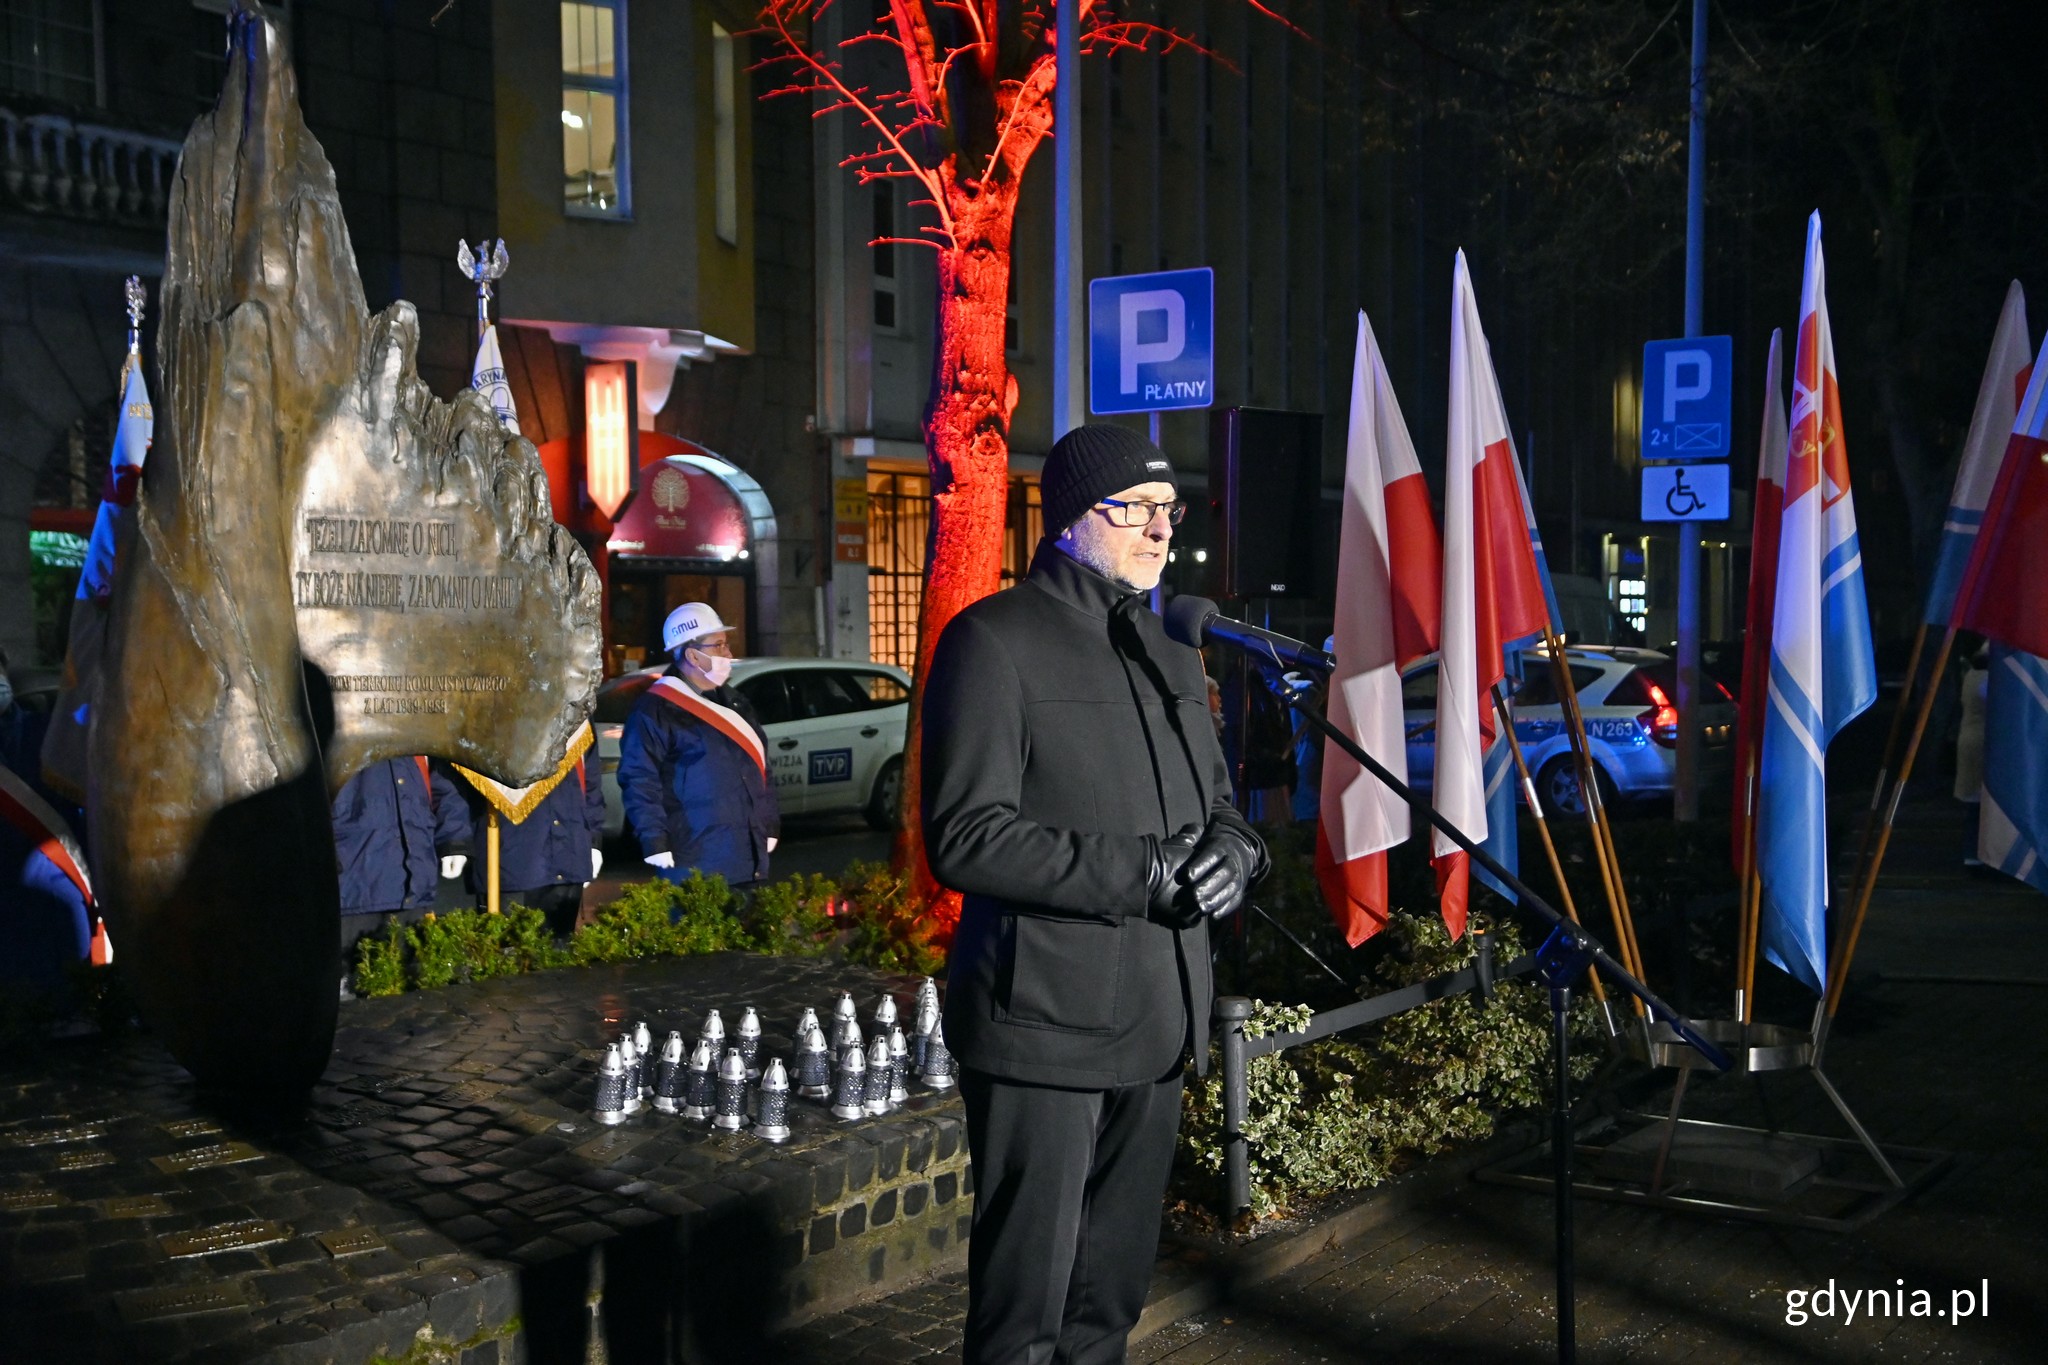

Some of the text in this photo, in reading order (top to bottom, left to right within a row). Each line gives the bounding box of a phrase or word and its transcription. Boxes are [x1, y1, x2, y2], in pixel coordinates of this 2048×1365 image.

[1120, 288, 1185, 395] P
[1145, 380, 1206, 401] PŁATNY
[1663, 349, 1712, 423] P
[348, 519, 410, 558] ZAPOMNĘ
[413, 521, 424, 556] O
[408, 574, 470, 612] ZAPOMNIJ
[472, 576, 481, 609] O
[364, 698, 372, 714] Z
[373, 698, 394, 714] LAT
[1592, 722, 1634, 737] N 263
[815, 757, 846, 776] TVP
